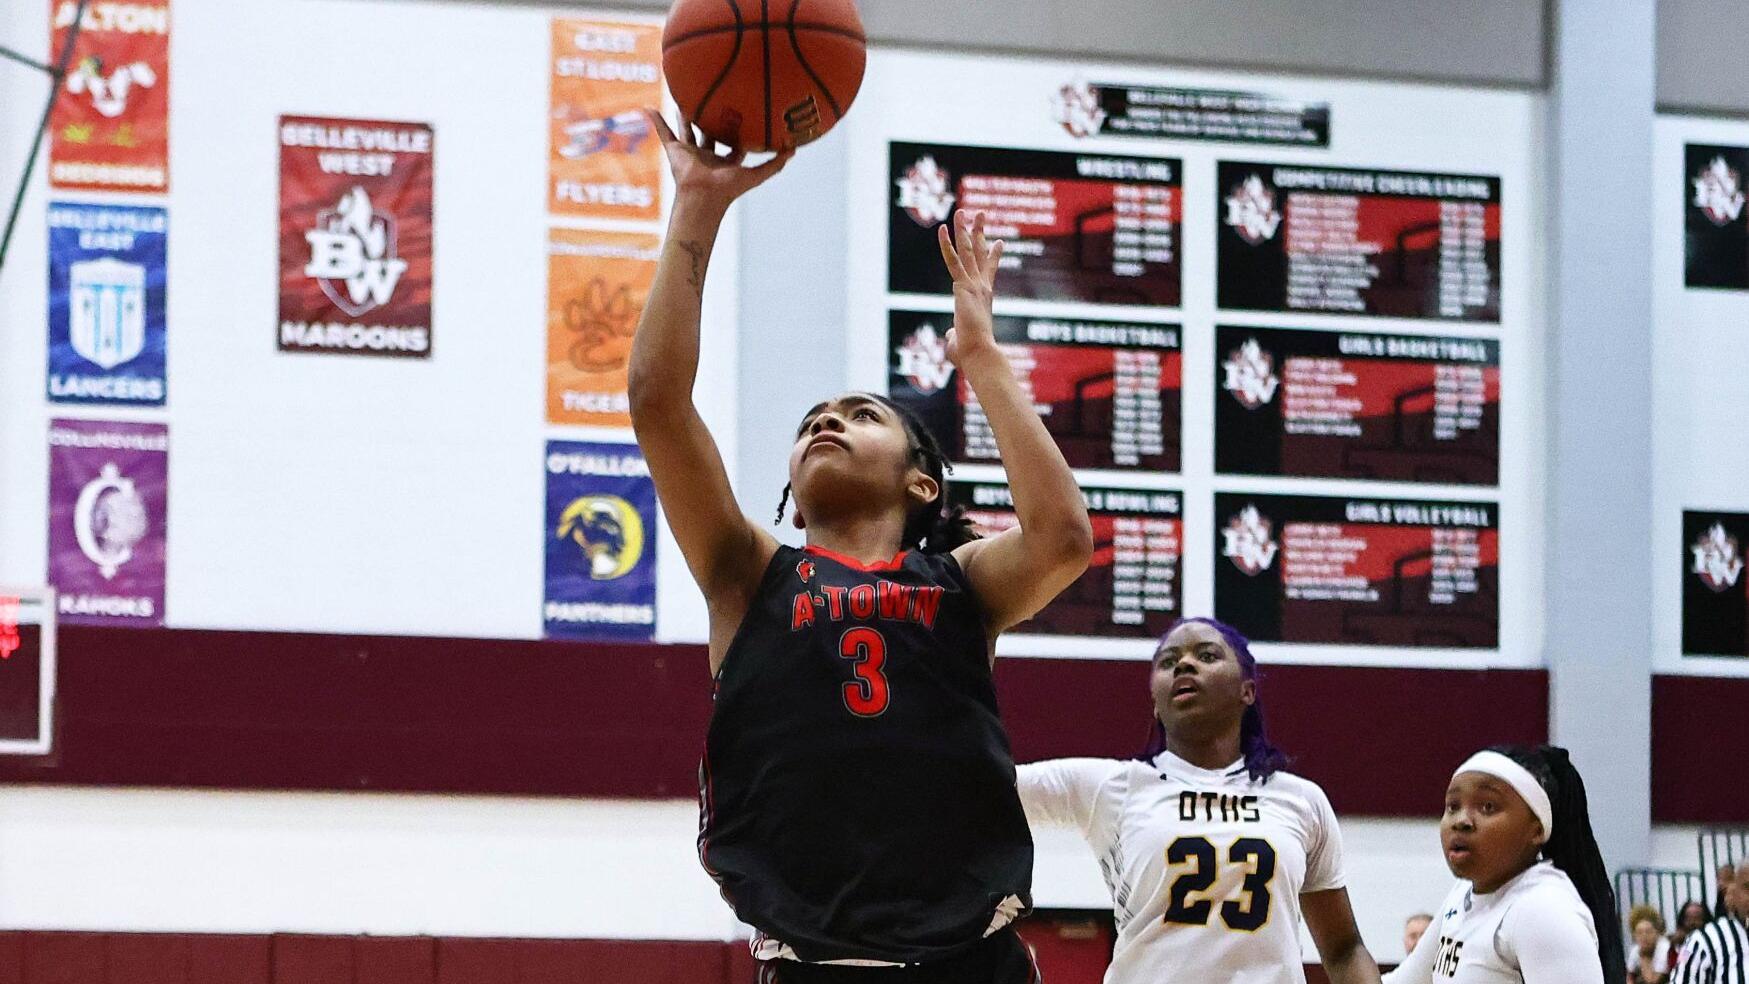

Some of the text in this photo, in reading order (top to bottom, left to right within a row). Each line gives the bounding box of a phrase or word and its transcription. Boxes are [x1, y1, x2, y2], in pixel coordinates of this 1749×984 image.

[280, 122, 429, 152] BELLEVILLE
[318, 152, 397, 177] WEST
[1076, 157, 1172, 181] WRESTLING
[1272, 168, 1374, 192] COMPETITIVE
[556, 181, 652, 208] FLYERS
[280, 320, 429, 352] MAROONS
[1074, 322, 1179, 348] BASKETBALL
[1387, 338, 1488, 362] BASKETBALL
[50, 375, 163, 400] LANCERS
[562, 391, 629, 414] TIGER
[1105, 492, 1180, 513] BOWLING
[1392, 504, 1489, 527] VOLLEYBALL
[791, 580, 946, 632] A-TOWN
[838, 626, 891, 718] 3
[1178, 790, 1261, 822] OTHS
[1163, 835, 1277, 934] 23
